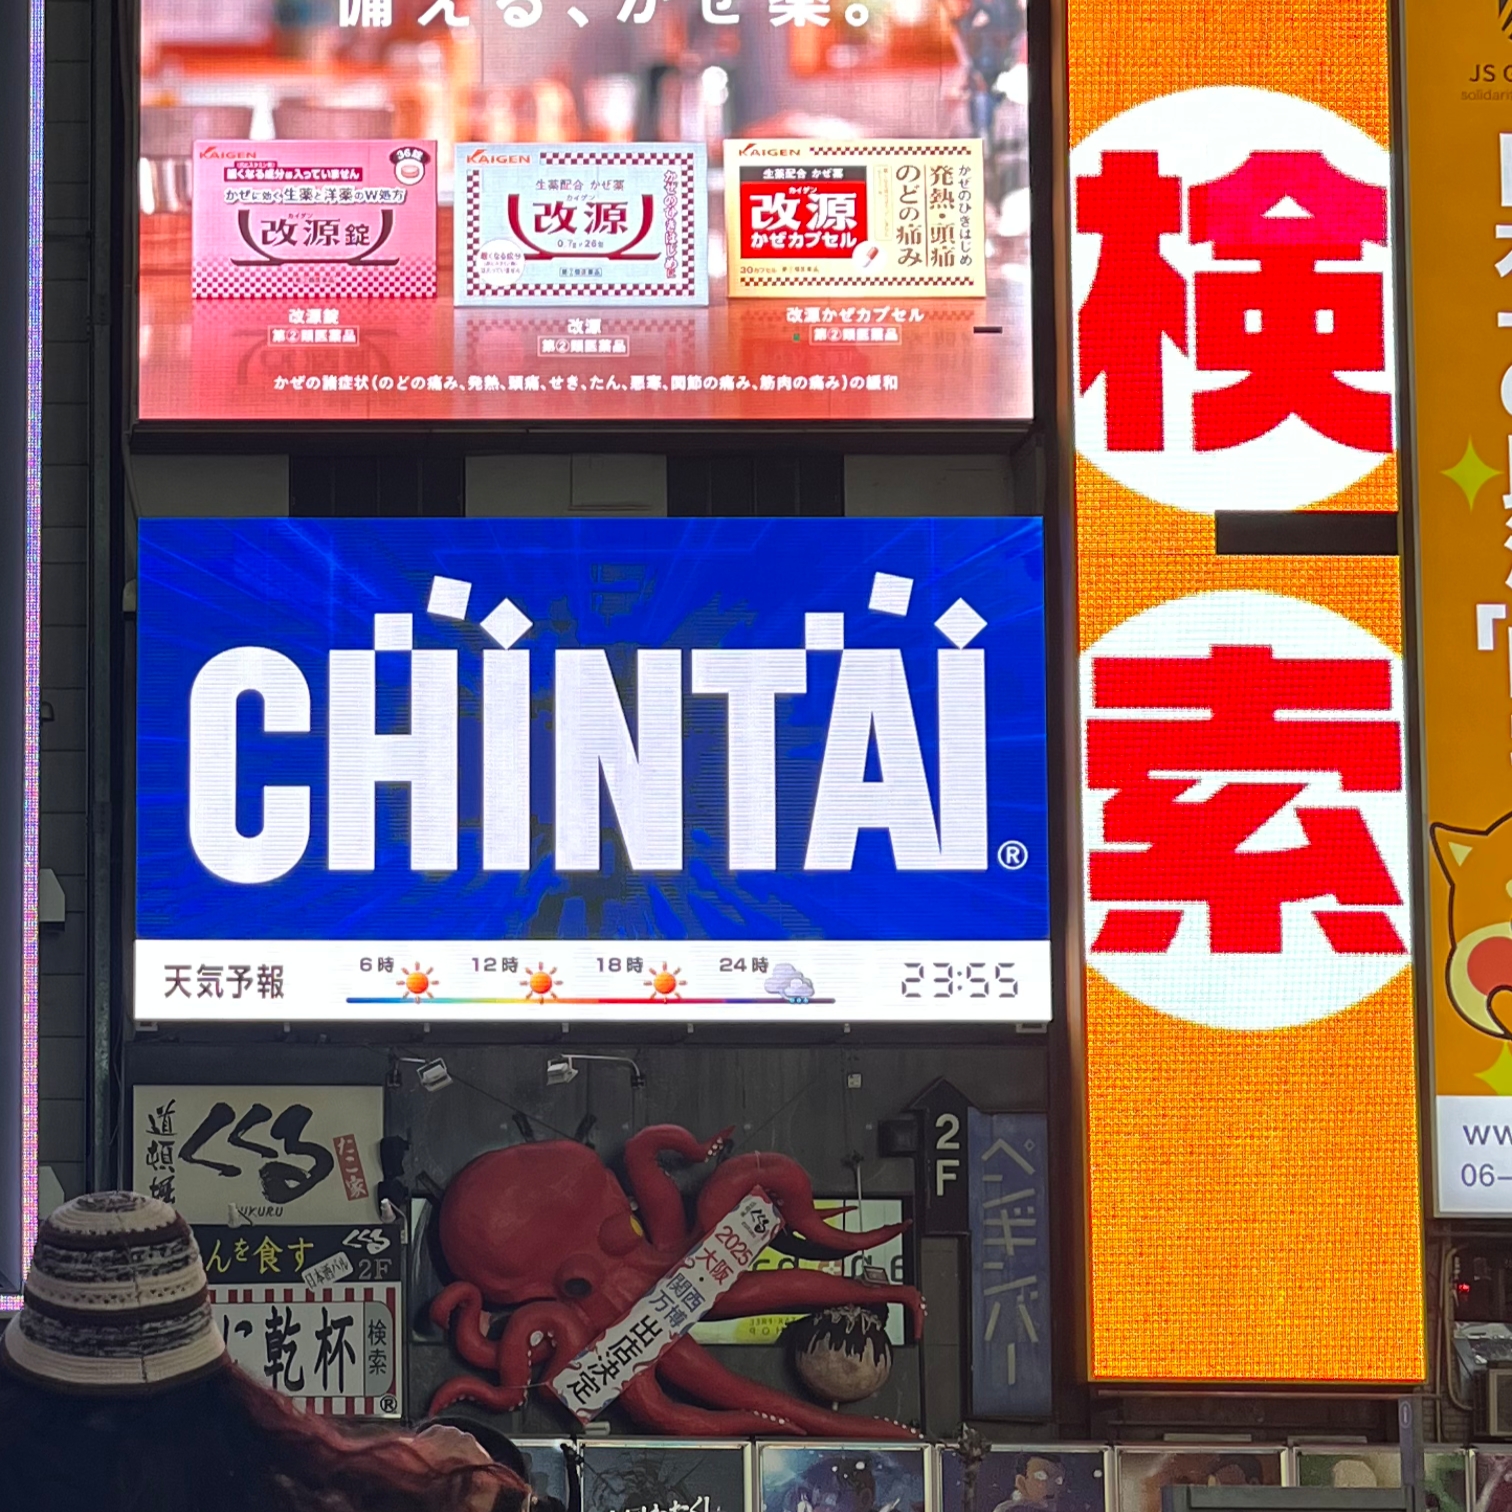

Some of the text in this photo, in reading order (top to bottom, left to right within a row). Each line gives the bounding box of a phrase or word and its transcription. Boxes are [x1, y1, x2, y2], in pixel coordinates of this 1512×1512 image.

[199, 146, 257, 159] KAIGEN
[467, 149, 531, 164] KAIGEN
[738, 143, 801, 157] KAIGEN
[535, 179, 625, 191] 生薬配合 かぜ薬
[532, 201, 629, 235] 改源
[749, 192, 858, 232] 改源
[896, 164, 923, 268] のどの痛み
[929, 164, 956, 268] 発熱・頭痛
[260, 217, 371, 247] 改源錠
[750, 231, 858, 249] かぜカプセル
[567, 318, 602, 335] 改源
[785, 306, 925, 324] 改源かぜカプセル
[1075, 149, 1410, 956] 検索
[188, 574, 989, 884] CHINTAI
[164, 963, 285, 999] 天気予報
[359, 957, 394, 973] 6時
[472, 957, 519, 973] 12時
[595, 957, 644, 973] 18時
[719, 957, 769, 973] 24時
[901, 962, 1019, 998] 23:55
[177, 1102, 335, 1204] くくる
[935, 1113, 961, 1196] 2F
[714, 1225, 754, 1267] 2025
[358, 1257, 393, 1281] 2F
[666, 1272, 706, 1313] 関西
[367, 1318, 388, 1375] 検索
[566, 1314, 664, 1405] 出店決定
